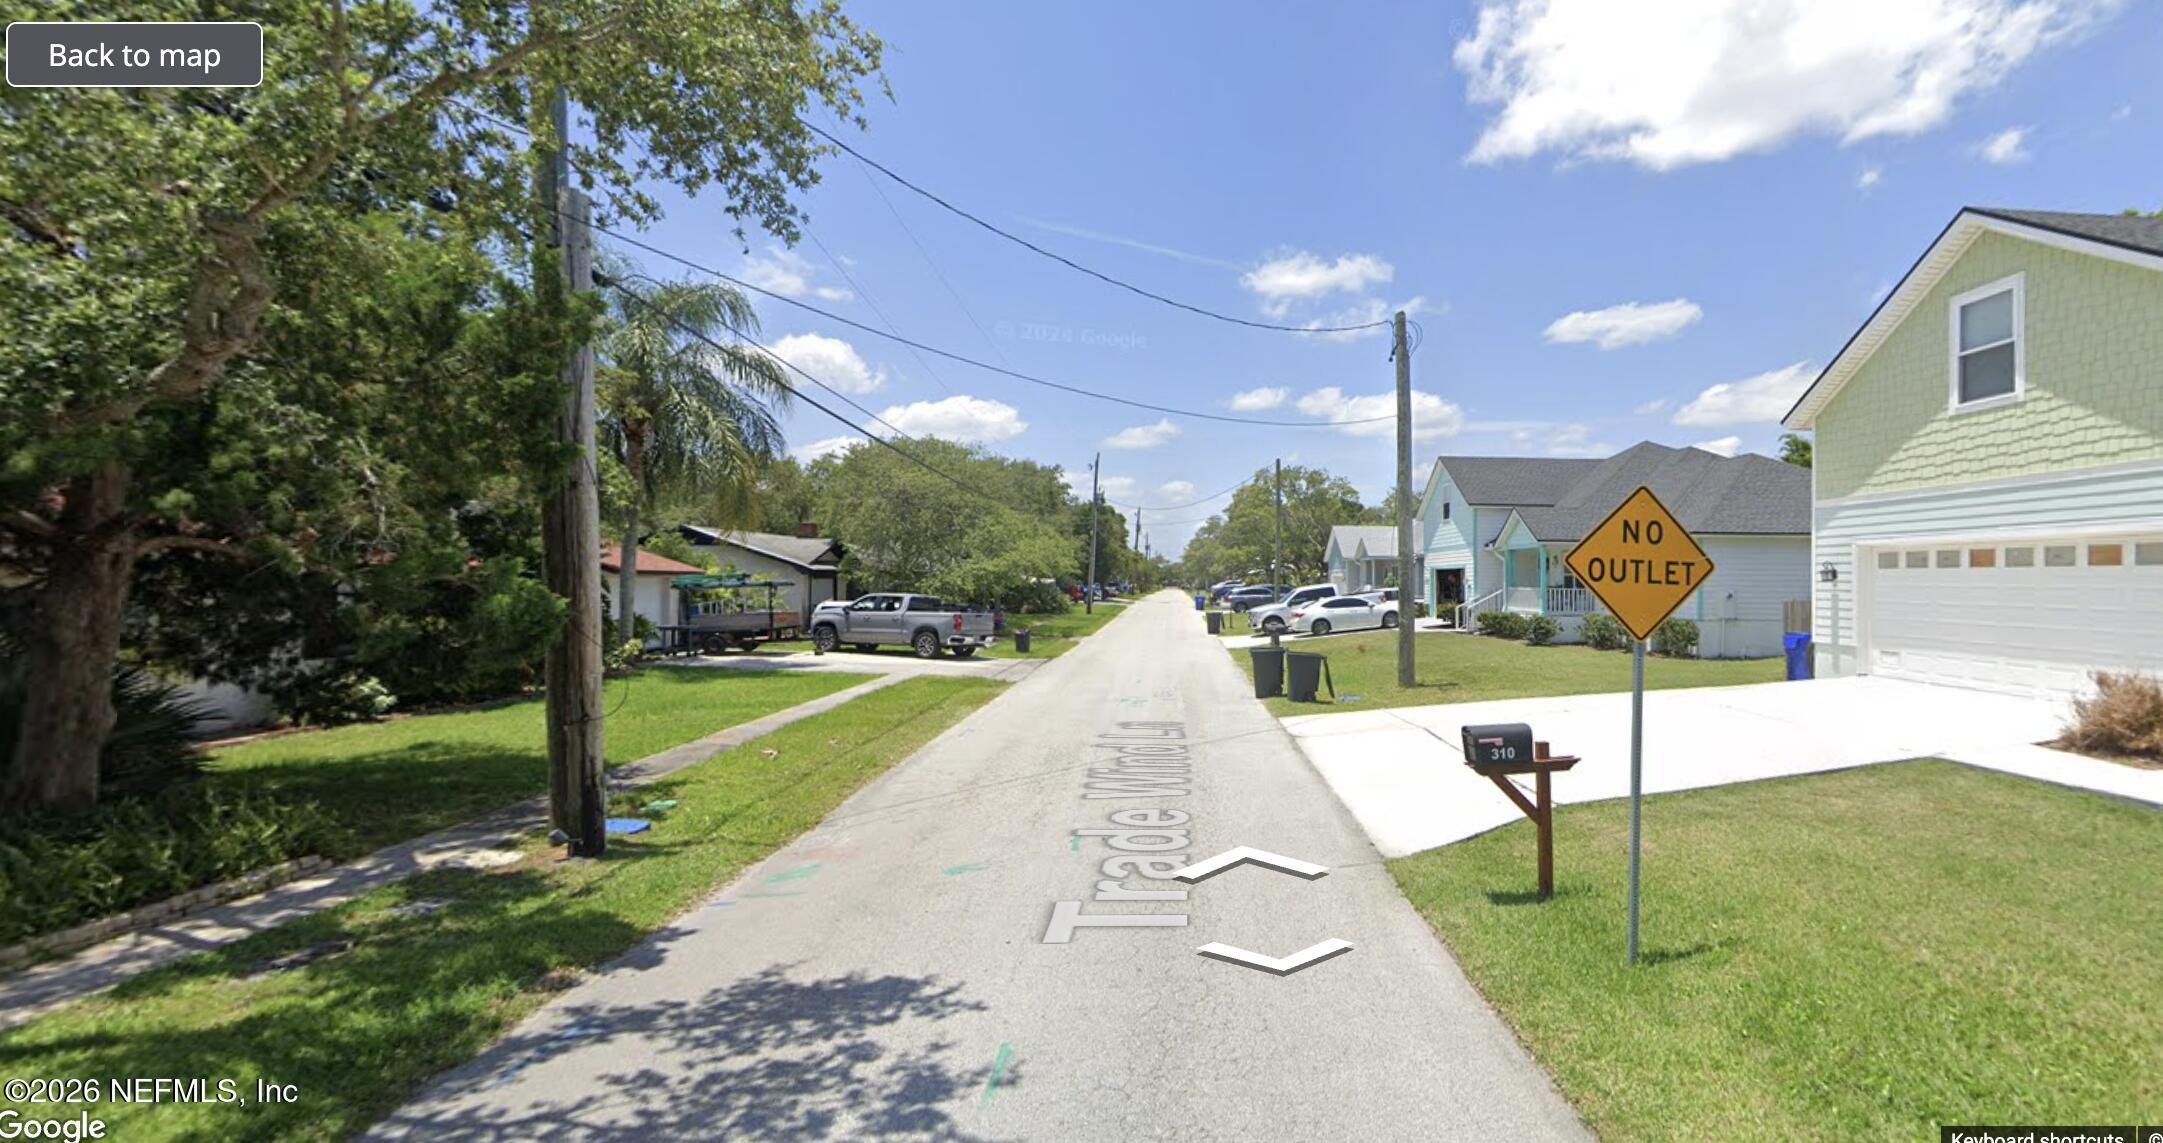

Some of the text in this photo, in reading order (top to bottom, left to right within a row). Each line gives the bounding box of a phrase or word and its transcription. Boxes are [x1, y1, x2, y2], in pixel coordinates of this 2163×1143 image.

[1622, 519, 1664, 545] NO
[1587, 557, 1696, 586] OUTLET
[1491, 746, 1516, 760] 310
